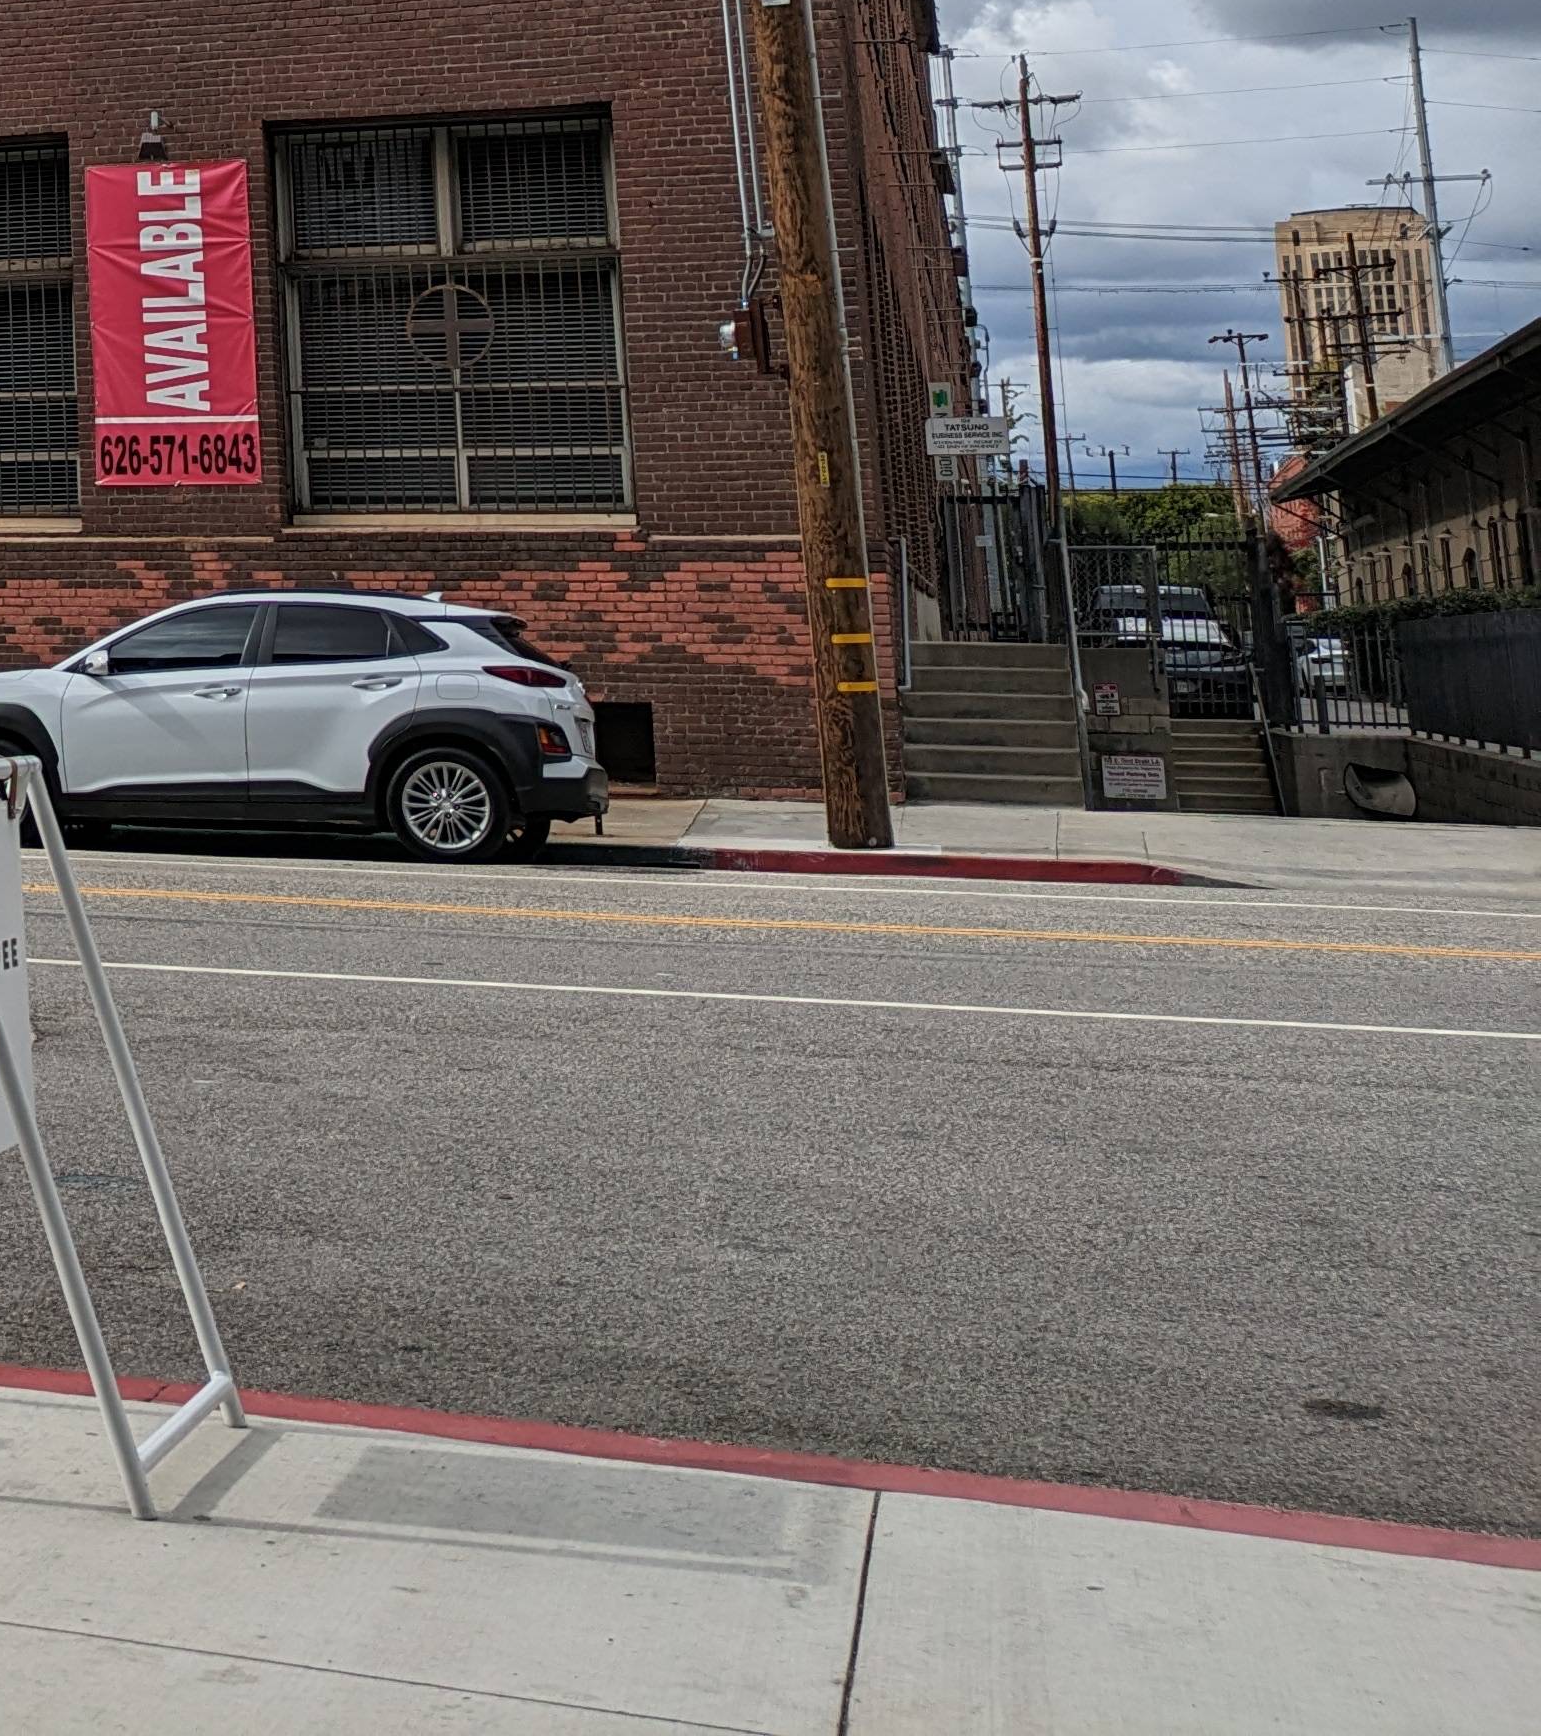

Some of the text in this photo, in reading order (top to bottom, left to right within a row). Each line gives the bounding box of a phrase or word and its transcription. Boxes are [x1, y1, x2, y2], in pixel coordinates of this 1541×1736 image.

[136, 168, 212, 412] AVAILABLE
[944, 423, 990, 432] TATSUNO
[99, 432, 257, 476] 626-571-6843
